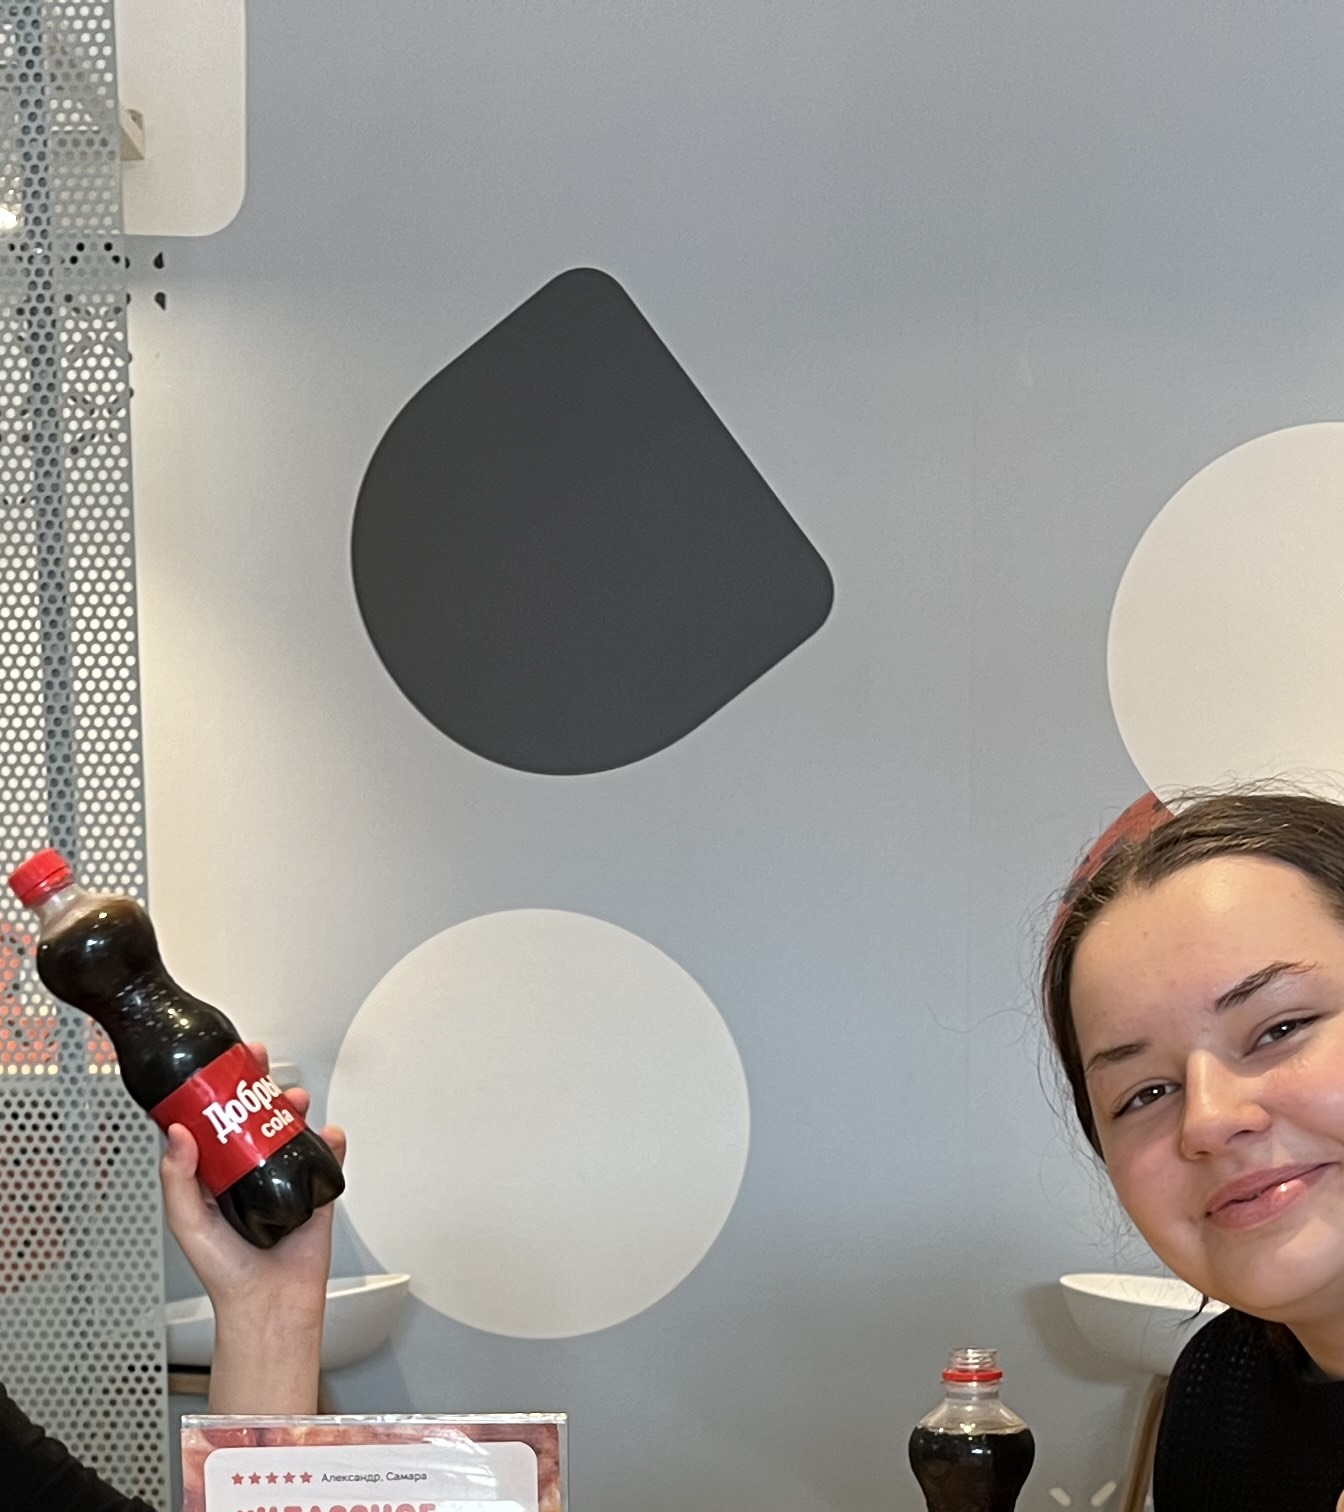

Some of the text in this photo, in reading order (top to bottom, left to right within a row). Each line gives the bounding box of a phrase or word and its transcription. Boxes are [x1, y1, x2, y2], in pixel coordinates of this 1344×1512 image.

[260, 1108, 296, 1138] cola
[321, 1471, 428, 1484] Александр, Самара
